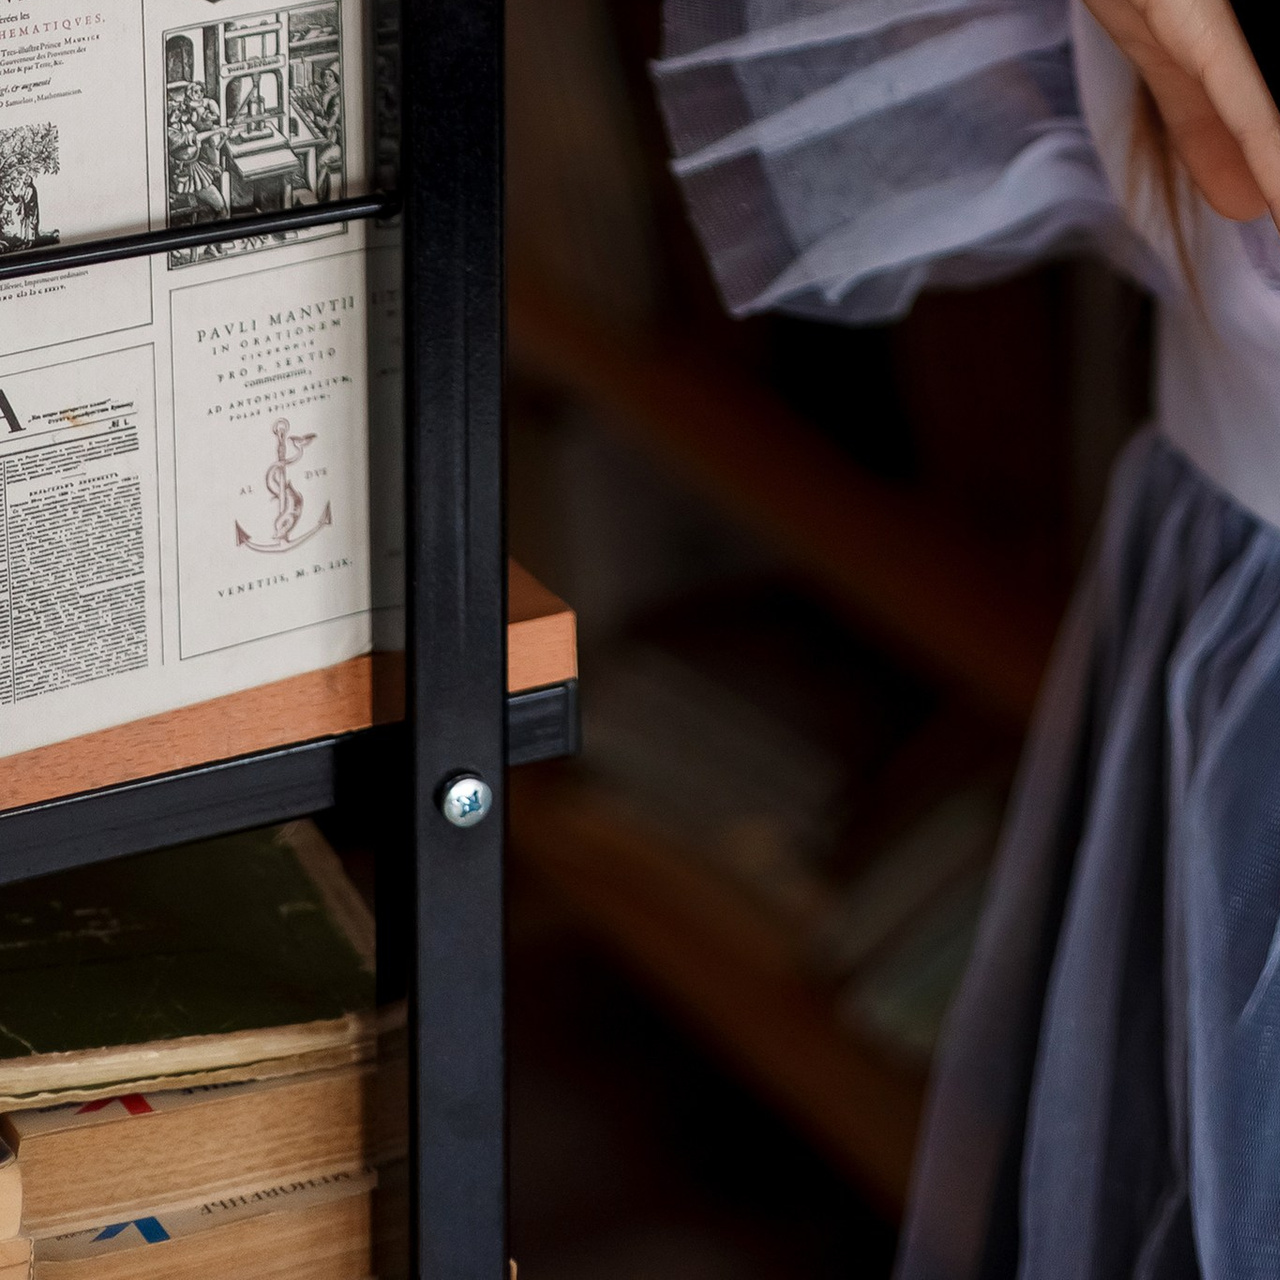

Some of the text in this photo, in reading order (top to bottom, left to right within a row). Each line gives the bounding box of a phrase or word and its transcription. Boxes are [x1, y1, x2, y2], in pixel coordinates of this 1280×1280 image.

[20, 11, 30, 20] les
[197, 319, 256, 343] PAVLI
[269, 295, 355, 327] MANVTII
[212, 317, 342, 356] IN ORATIONEM
[217, 367, 248, 383] PRO
